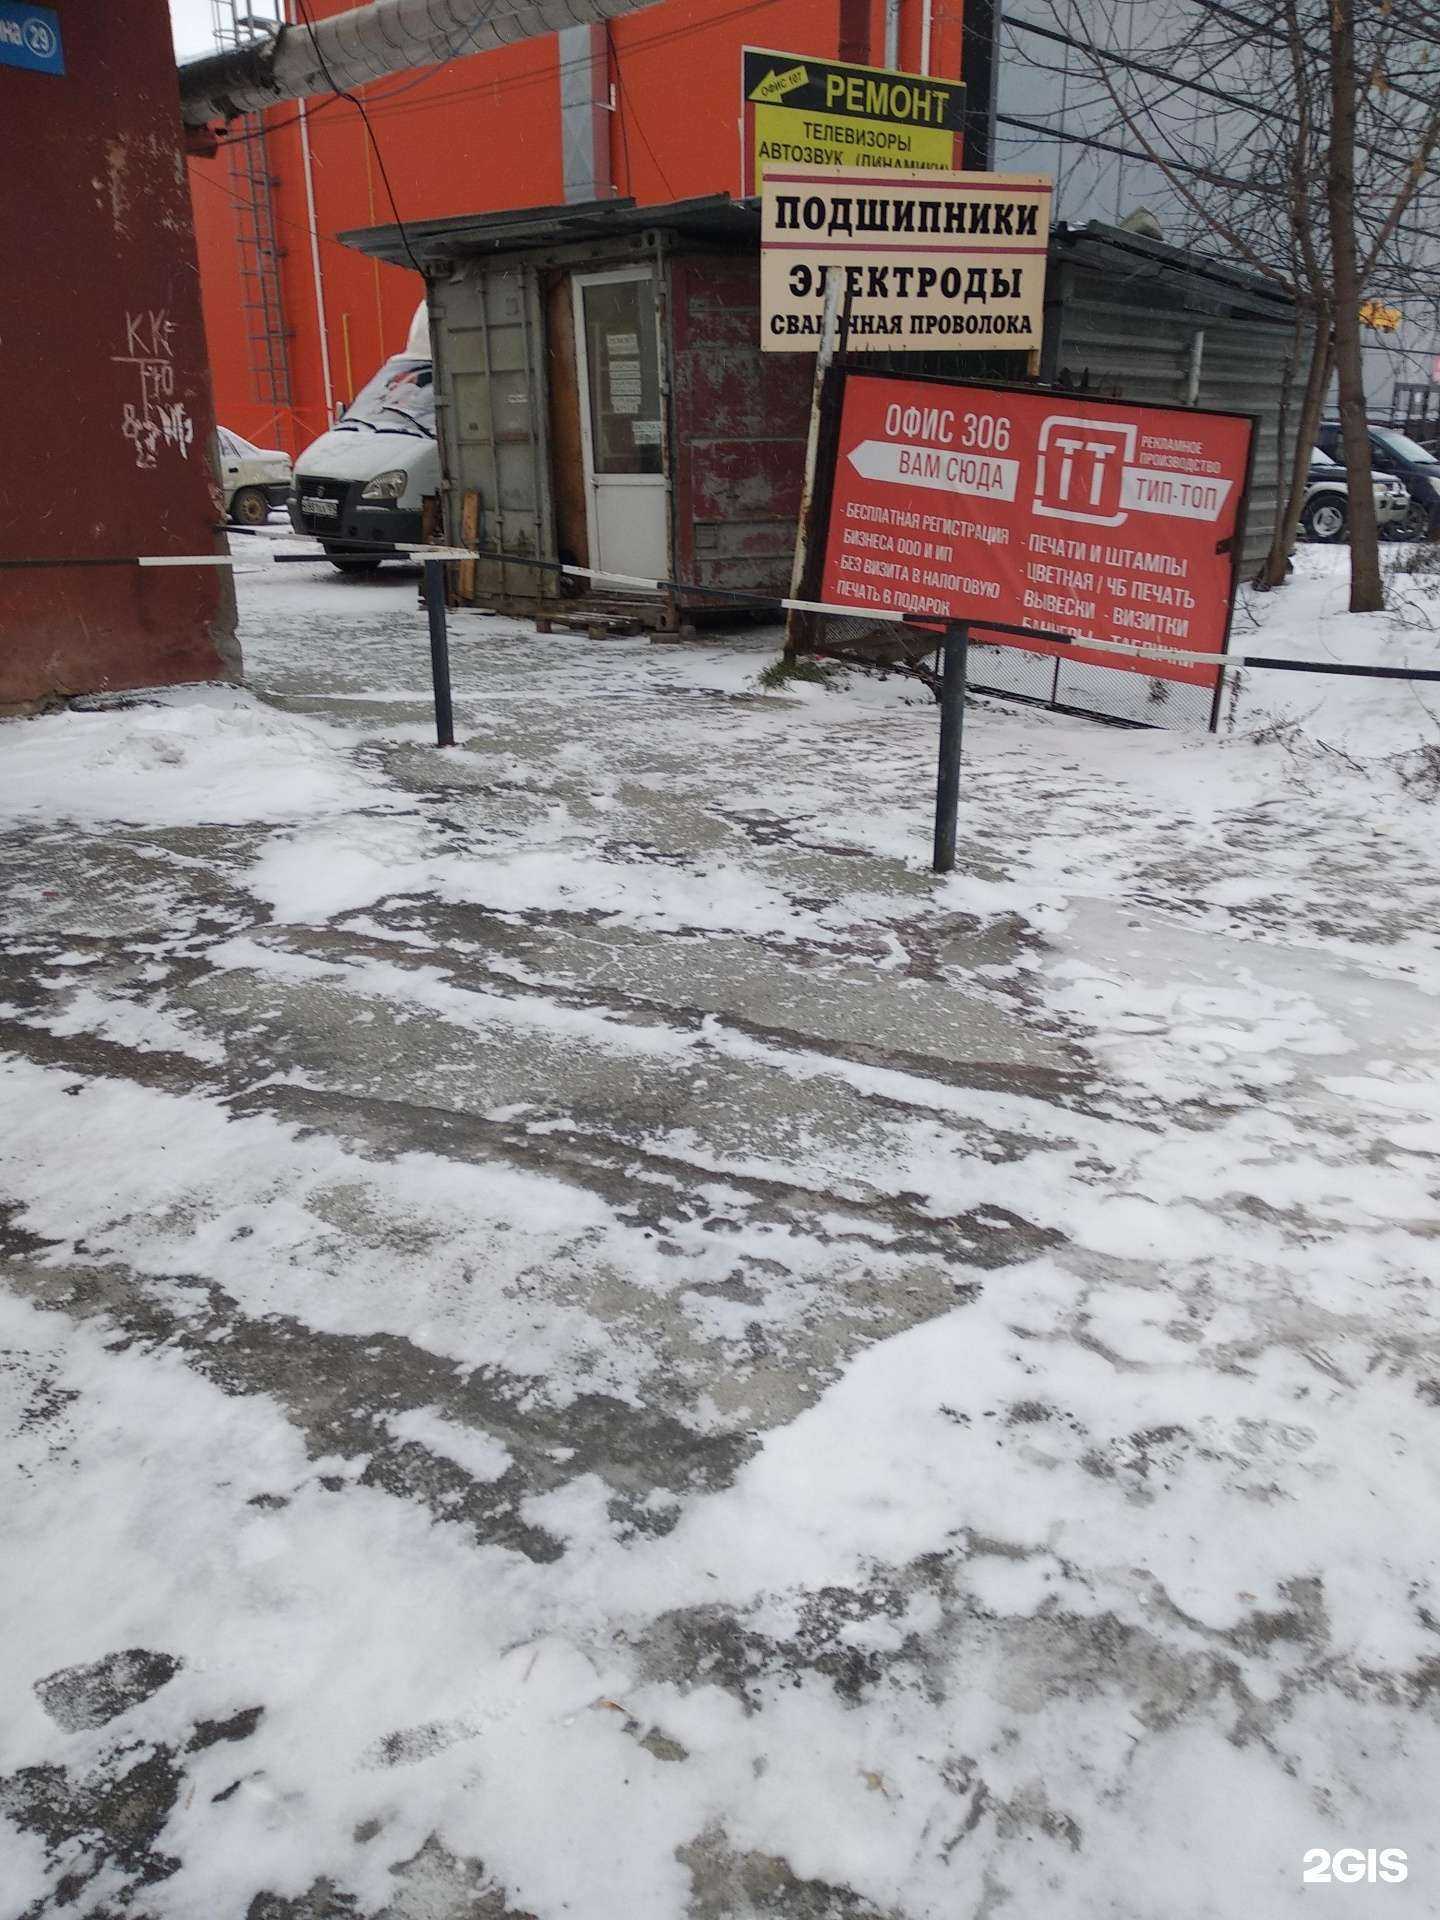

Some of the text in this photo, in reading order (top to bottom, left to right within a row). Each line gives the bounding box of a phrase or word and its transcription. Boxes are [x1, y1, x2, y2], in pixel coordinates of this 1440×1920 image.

[31, 25, 50, 51] 29
[825, 74, 950, 124] РЕМОНТ
[759, 141, 844, 166] АВТОЗВУК
[803, 121, 912, 152] ТЕЛЕВИЗОРЫ
[775, 195, 1040, 237] ПОДШИПНИКИ
[770, 314, 1033, 335] СВАЧНАЯ ПРОВОЛОКА
[885, 403, 1011, 451] ОФИС 306
[1142, 435, 1203, 455] РЕКЛАМНОЕ
[899, 450, 1004, 492] ВАМ СЮДА
[1140, 452, 1222, 474] ПРОИЗВОДСТВО
[1136, 477, 1217, 511] ТИП-ТОП
[846, 502, 1010, 545] БЕСПЛАТНАЯ РЕГИСТРАЦИЯ
[843, 528, 954, 563] БИЗНЕСА ООО И ИП
[1029, 533, 1188, 578] ПЕЧАТИ И ШТАМПЫ
[841, 554, 1000, 599] БЕЗ ВИЗИТА В НАЛОГОВУЮ
[1027, 562, 1094, 592] ЦВЕТНАЯ
[1107, 576, 1128, 597] ЧБ
[1131, 581, 1196, 610] ПЕЧАТЬ
[837, 580, 950, 616] ПЕЧАТЬ В ПОДАРОК
[1023, 589, 1190, 638] ВЫВЕСКИ ВИЗИТКИ
